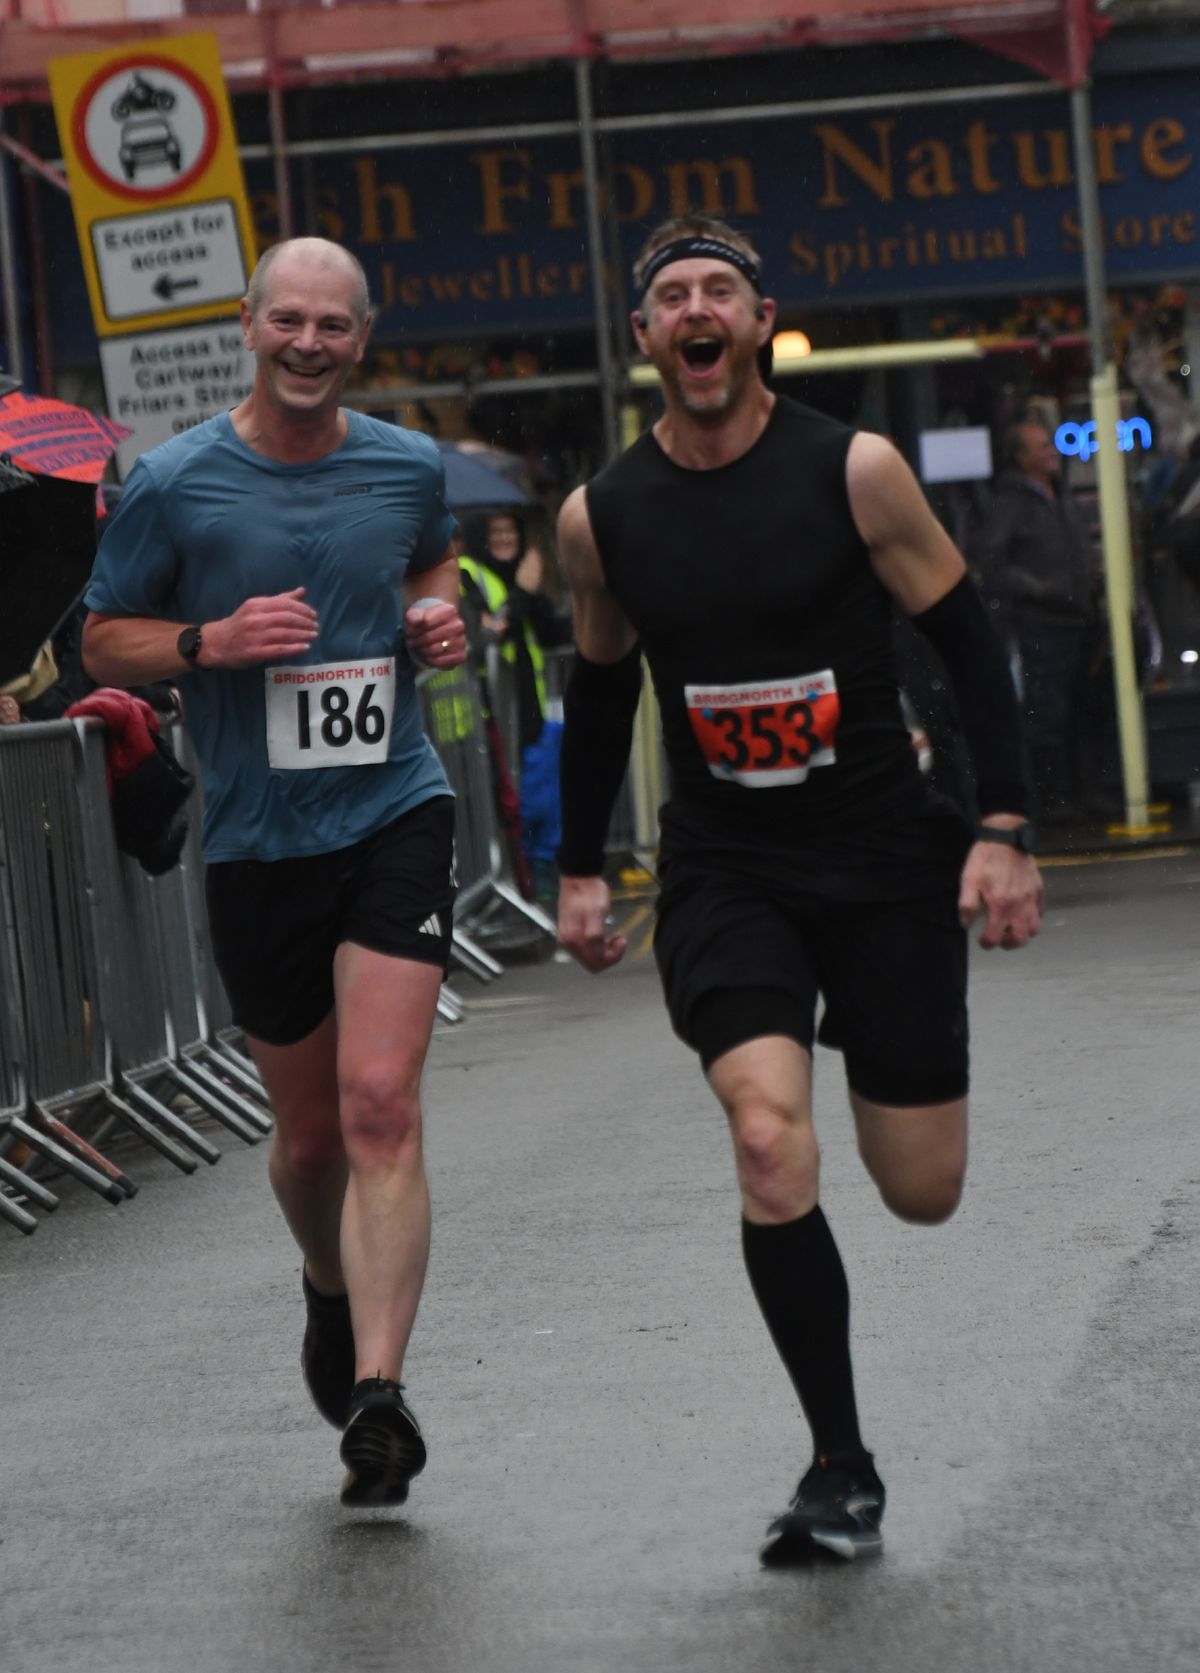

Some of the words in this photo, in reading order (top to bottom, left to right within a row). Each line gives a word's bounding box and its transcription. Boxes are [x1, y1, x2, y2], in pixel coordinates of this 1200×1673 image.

[470, 149, 760, 236] From
[813, 116, 1192, 208] Nature
[105, 219, 185, 250] Except
[193, 213, 223, 234] for
[789, 213, 1026, 287] Spiritual
[1061, 208, 1196, 253] Sore
[131, 242, 207, 272] access
[131, 339, 210, 364] Access
[218, 333, 241, 352] to
[135, 357, 242, 390] Cartway/
[118, 394, 185, 416] Friars
[274, 668, 364, 684] BRIDGNORTH
[369, 665, 391, 677] 10K
[694, 687, 793, 705] BRIDGNORTH
[297, 683, 385, 750] 186
[713, 702, 820, 769] 353
